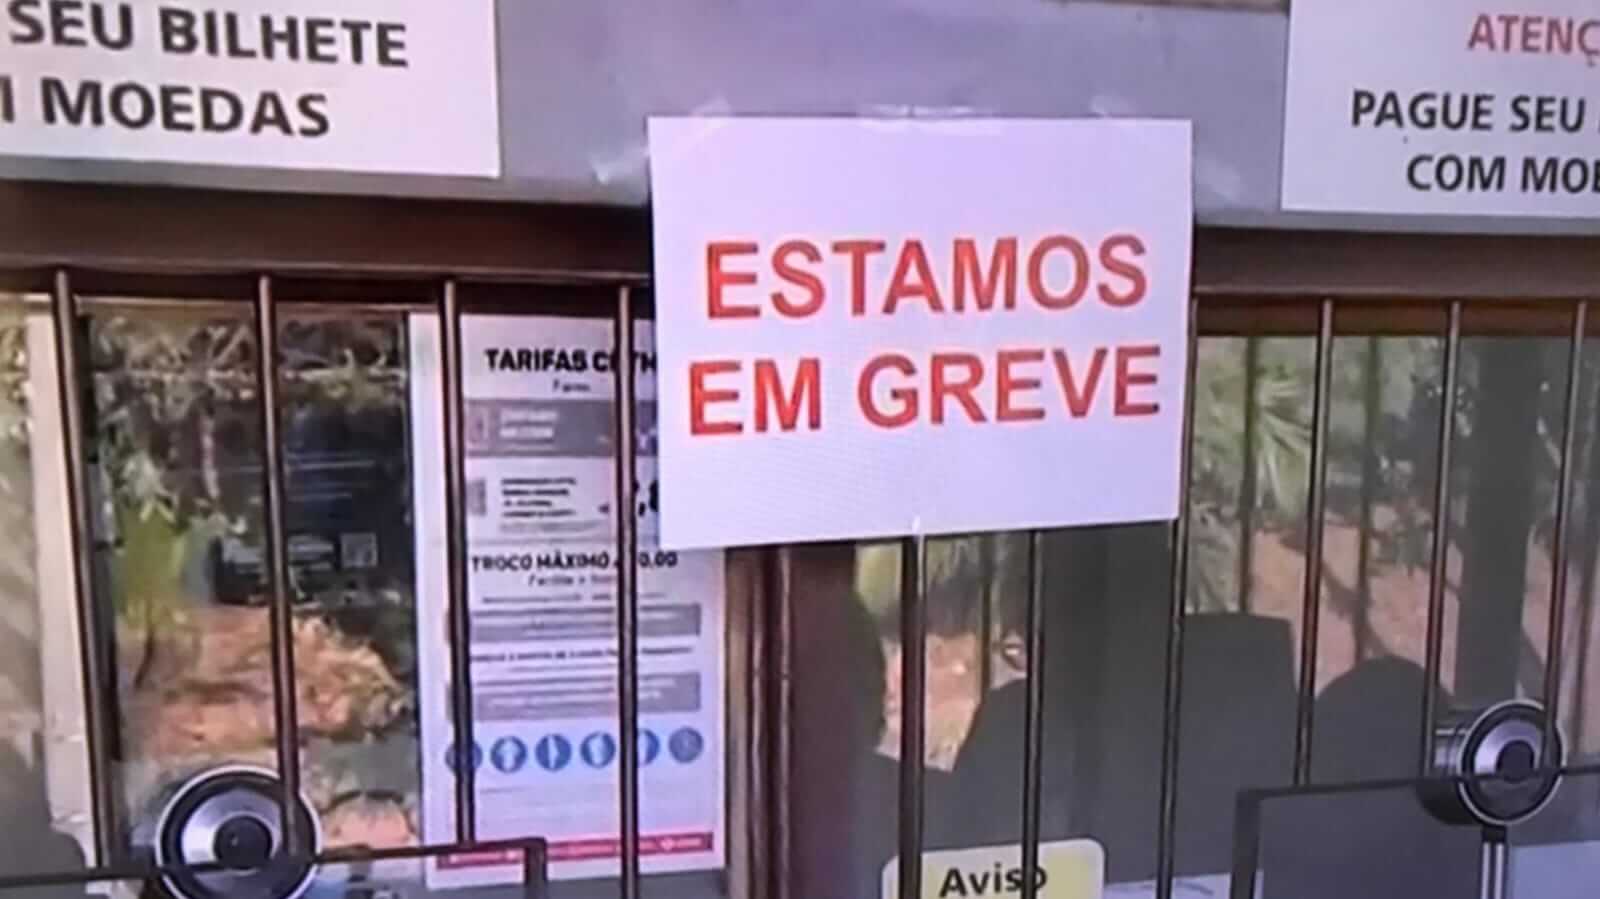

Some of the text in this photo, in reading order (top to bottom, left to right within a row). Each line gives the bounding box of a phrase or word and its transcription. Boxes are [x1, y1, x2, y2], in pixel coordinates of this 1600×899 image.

[8, 0, 409, 68] SEU BILHETE
[41, 76, 329, 138] MOEDAS
[1351, 88, 1495, 132] PAGUE
[1509, 94, 1586, 133] SEU
[1406, 153, 1506, 193] COM
[705, 234, 1148, 320] ESTAMOS
[485, 348, 588, 373] TARIFAS
[688, 344, 1161, 436] EM GREVE
[472, 553, 533, 572] TROCO
[536, 549, 610, 571] MÁXIMO
